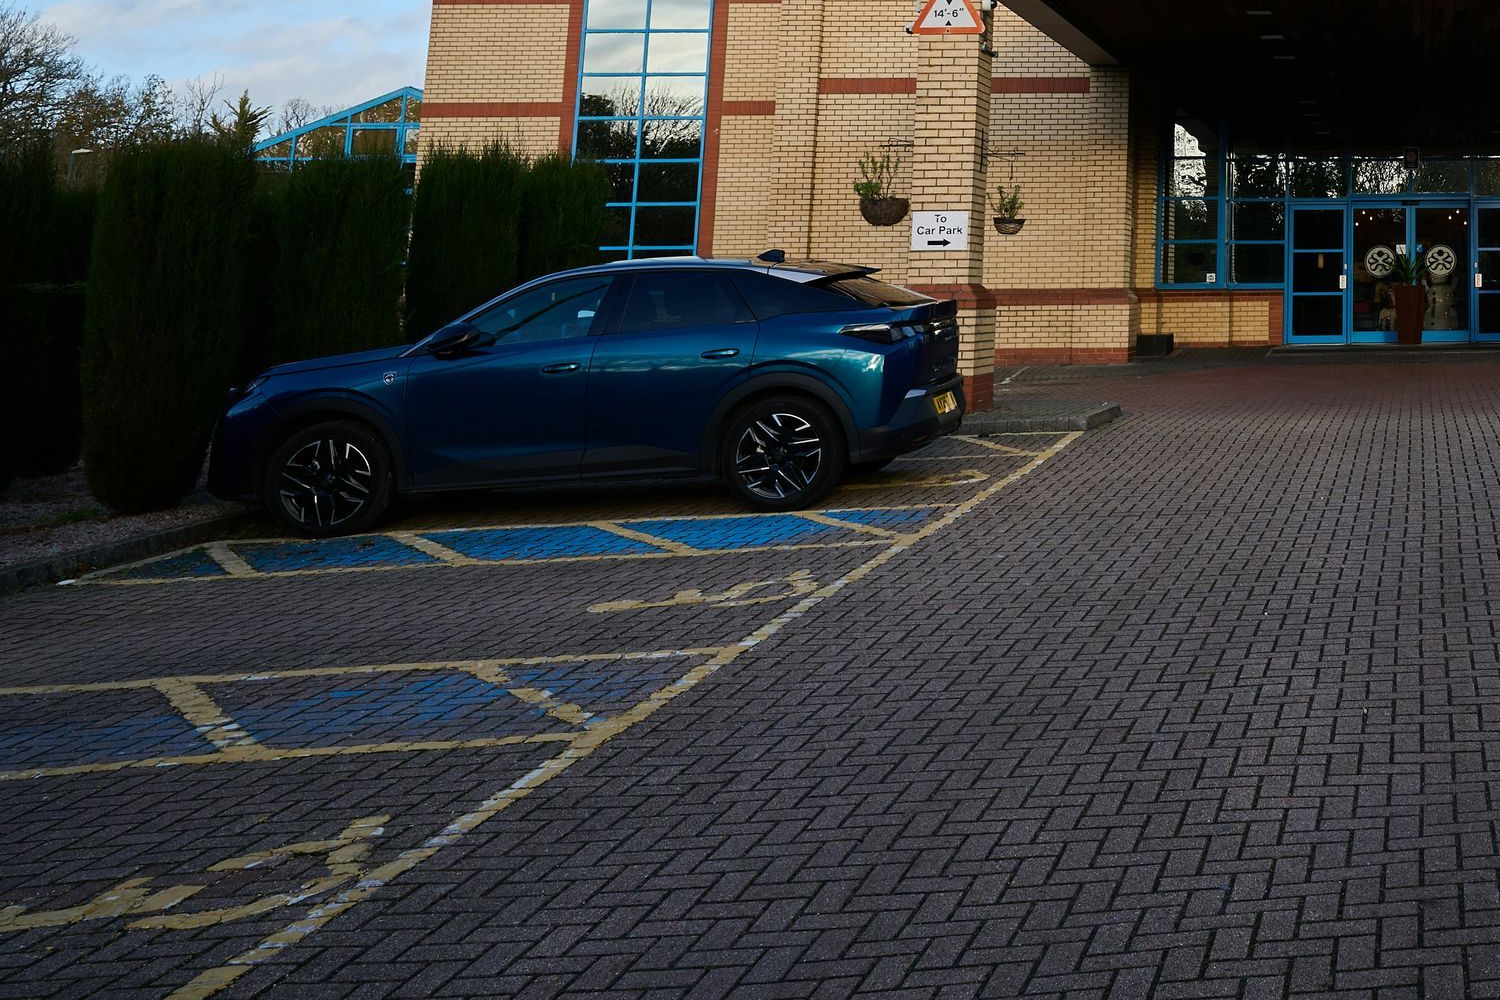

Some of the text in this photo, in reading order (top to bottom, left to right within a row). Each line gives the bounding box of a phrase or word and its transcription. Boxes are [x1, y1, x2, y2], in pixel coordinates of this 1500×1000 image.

[934, 214, 947, 223] To
[916, 225, 963, 235] Car Park
